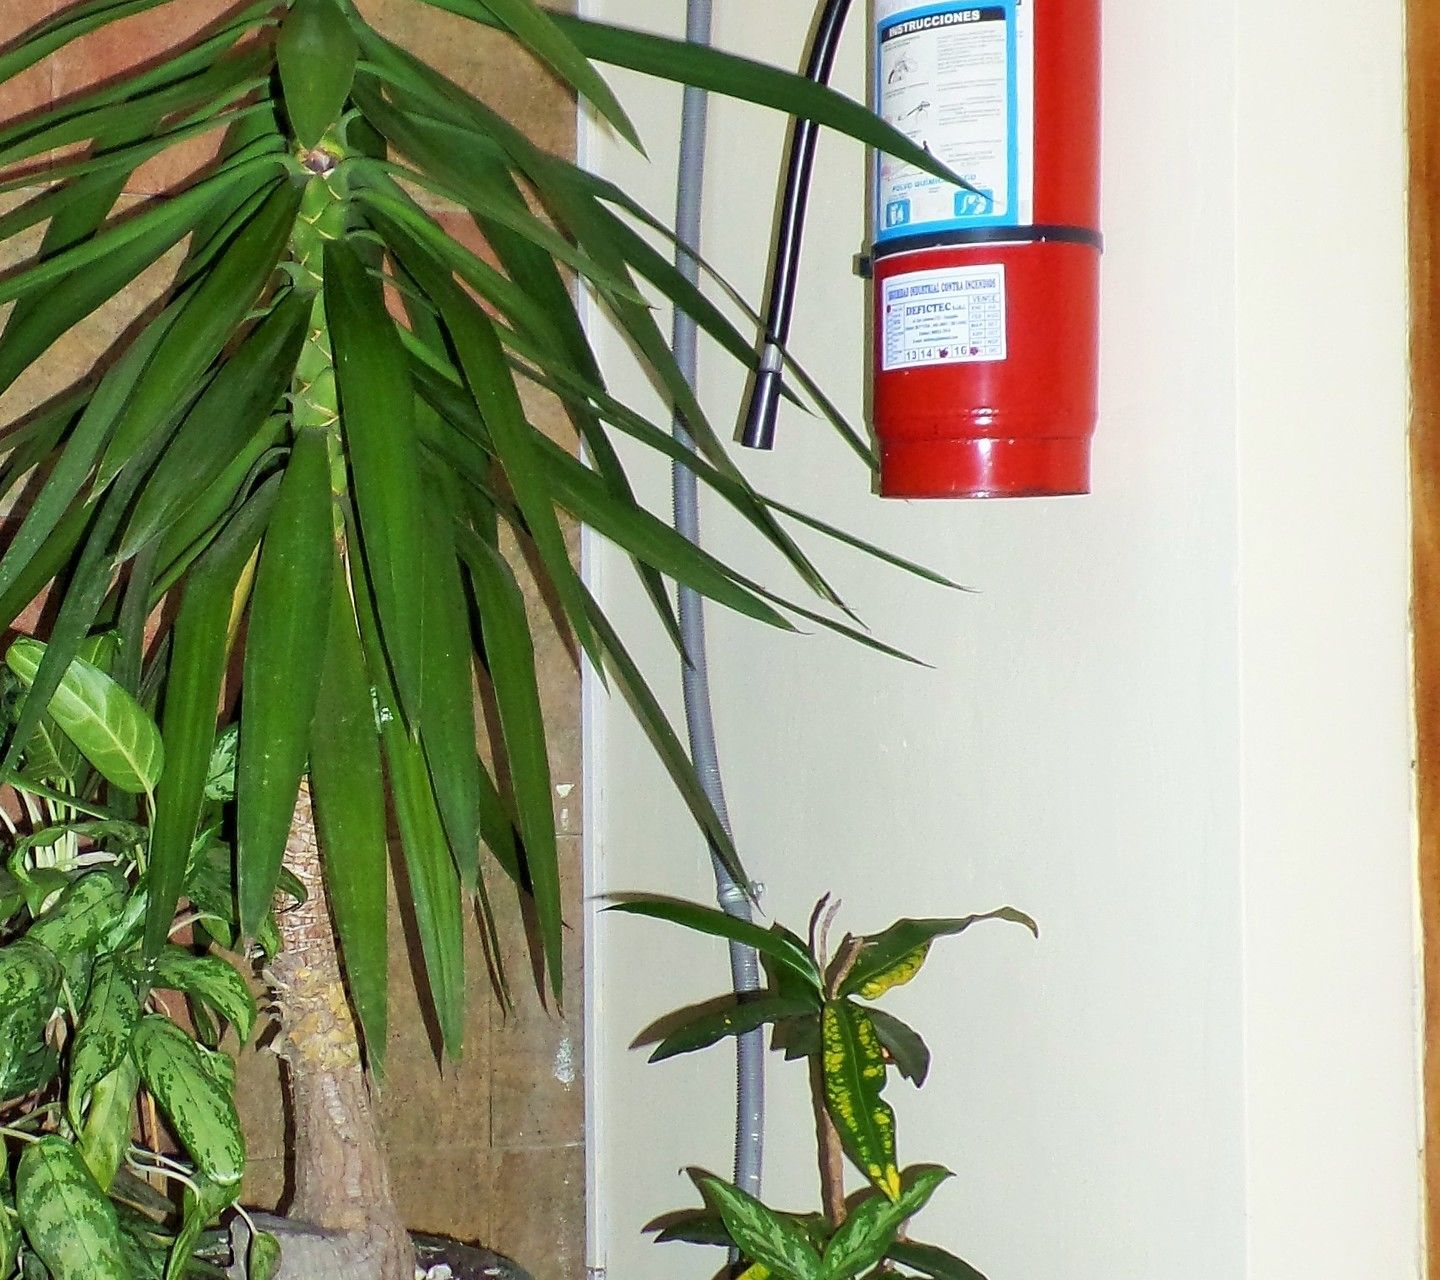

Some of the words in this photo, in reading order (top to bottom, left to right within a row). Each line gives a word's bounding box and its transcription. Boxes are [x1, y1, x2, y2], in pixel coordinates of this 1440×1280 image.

[888, 9, 981, 38] INSTRUCCIONES
[906, 302, 952, 316] DEFICTEC
[906, 350, 917, 360] 13
[920, 348, 933, 359] 14
[955, 345, 968, 356] 16
